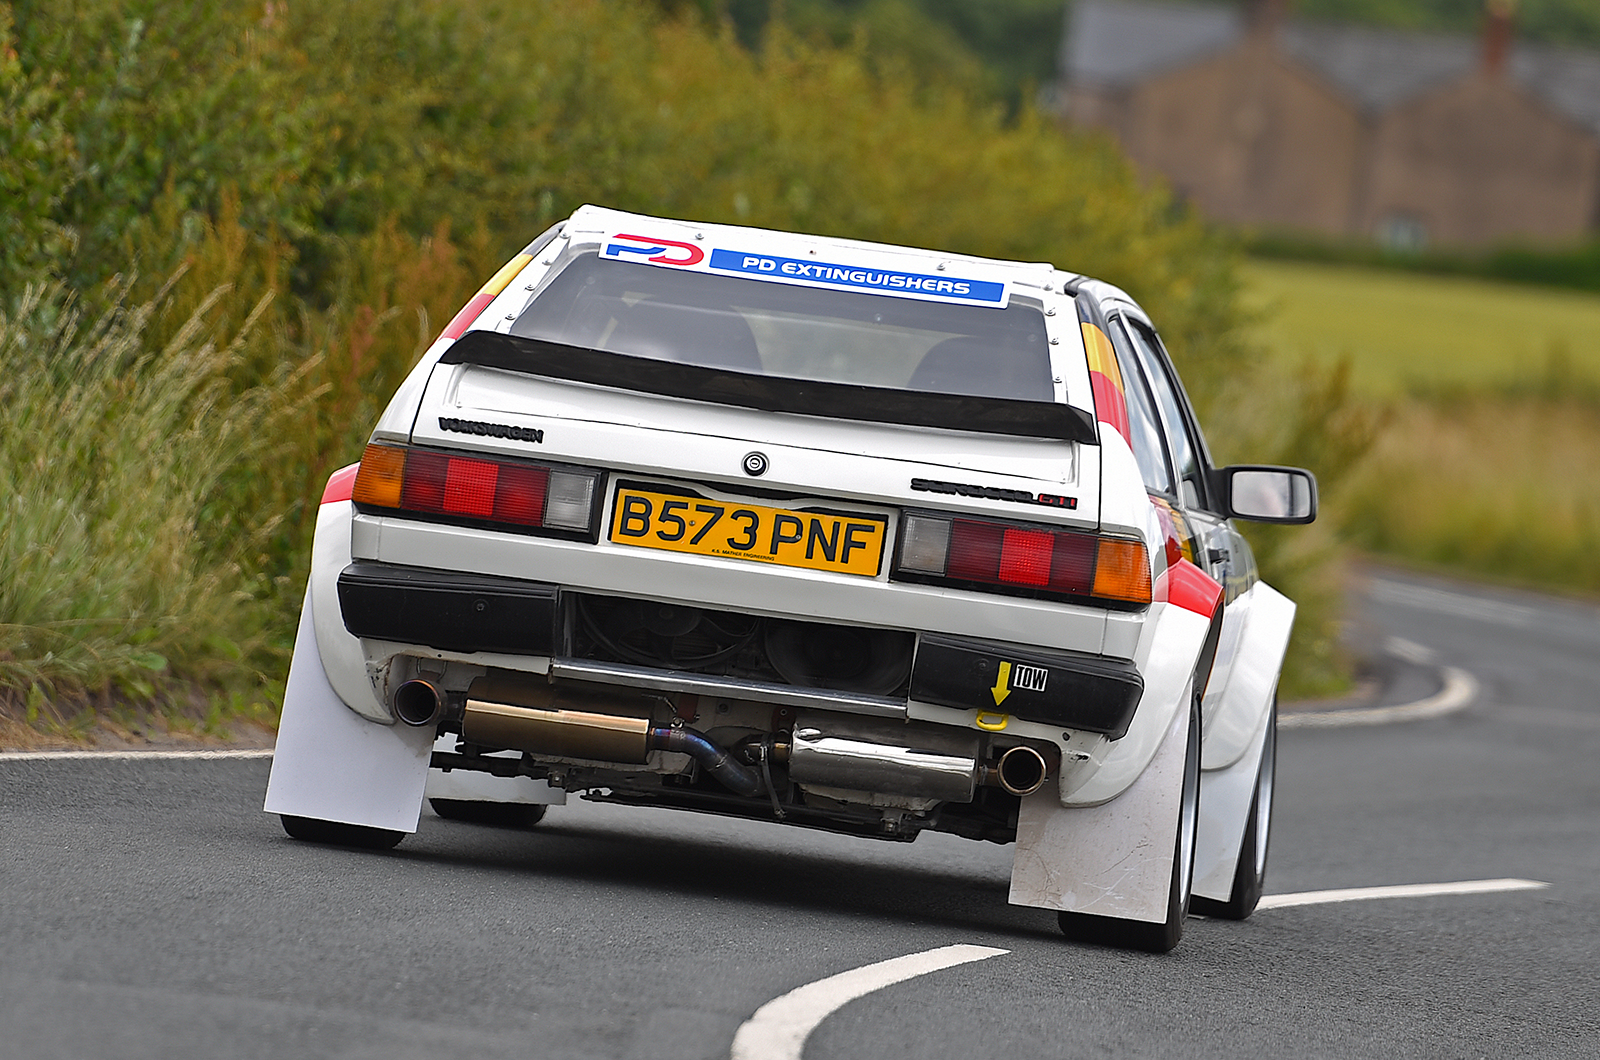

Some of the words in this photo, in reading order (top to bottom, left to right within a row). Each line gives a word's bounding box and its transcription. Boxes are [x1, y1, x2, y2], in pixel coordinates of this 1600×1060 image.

[742, 256, 777, 274] PD
[781, 262, 971, 295] EXTINGUISHERS
[438, 416, 544, 444] VOLKSWAGEN
[619, 495, 760, 551] B573
[769, 513, 876, 564] PNF
[1015, 665, 1047, 690] TOW
